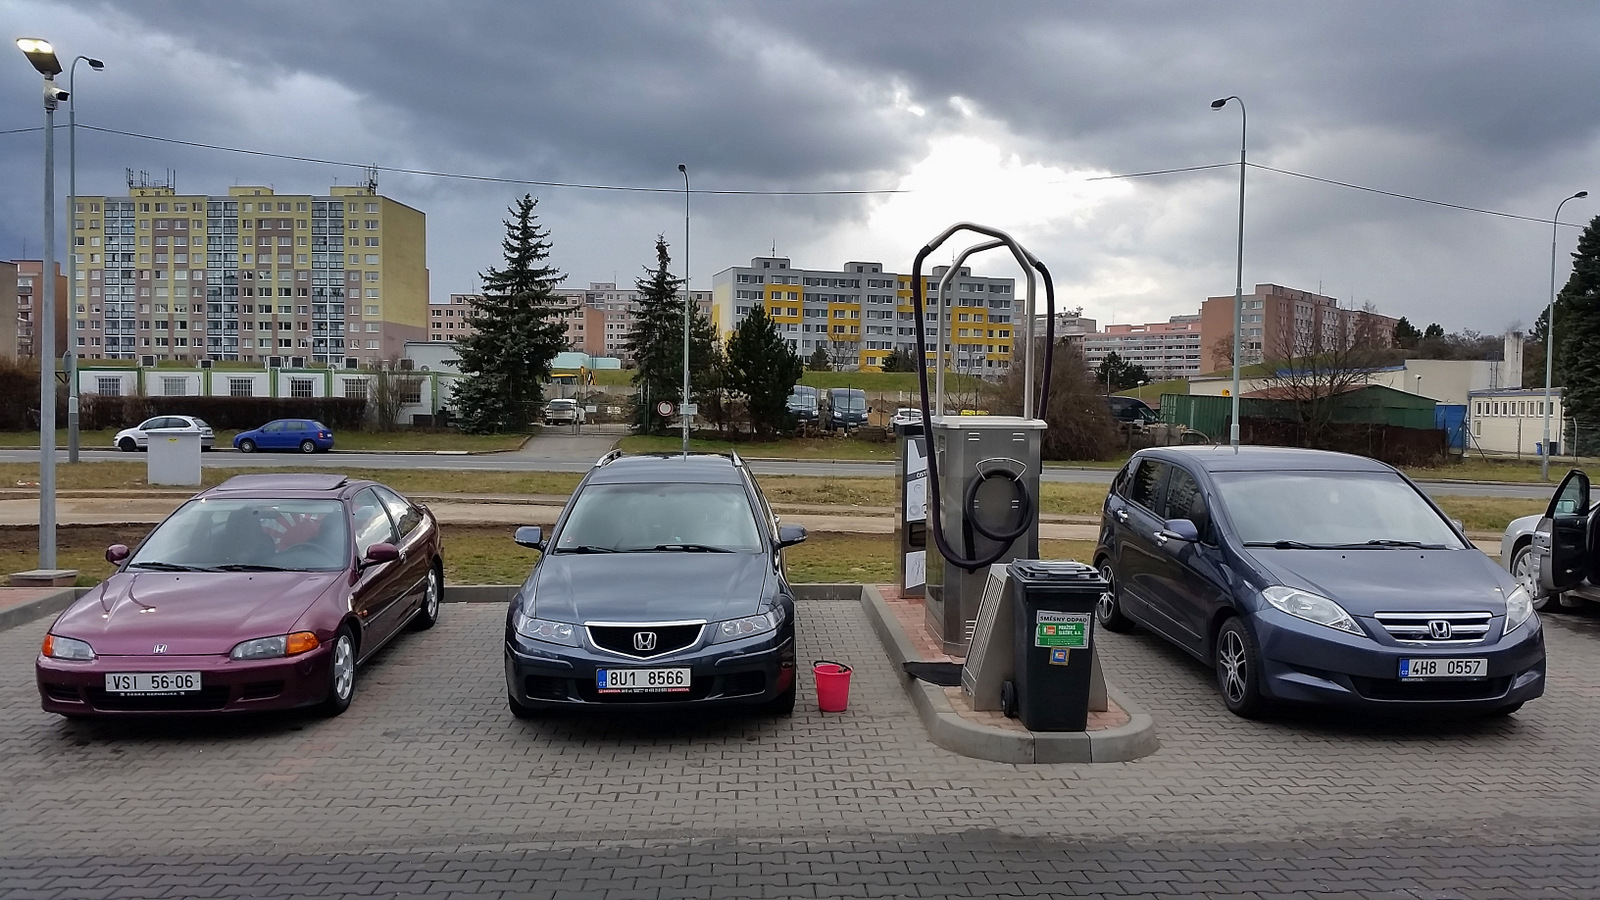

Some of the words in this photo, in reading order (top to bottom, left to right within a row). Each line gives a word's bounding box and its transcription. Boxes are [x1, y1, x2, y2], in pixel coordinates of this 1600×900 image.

[1412, 661, 1437, 675] 4H8
[1447, 661, 1481, 674] 0557
[113, 675, 137, 690] VSI
[151, 674, 193, 689] 56-06
[610, 671, 636, 686] 8U1
[648, 670, 684, 685] 8566
